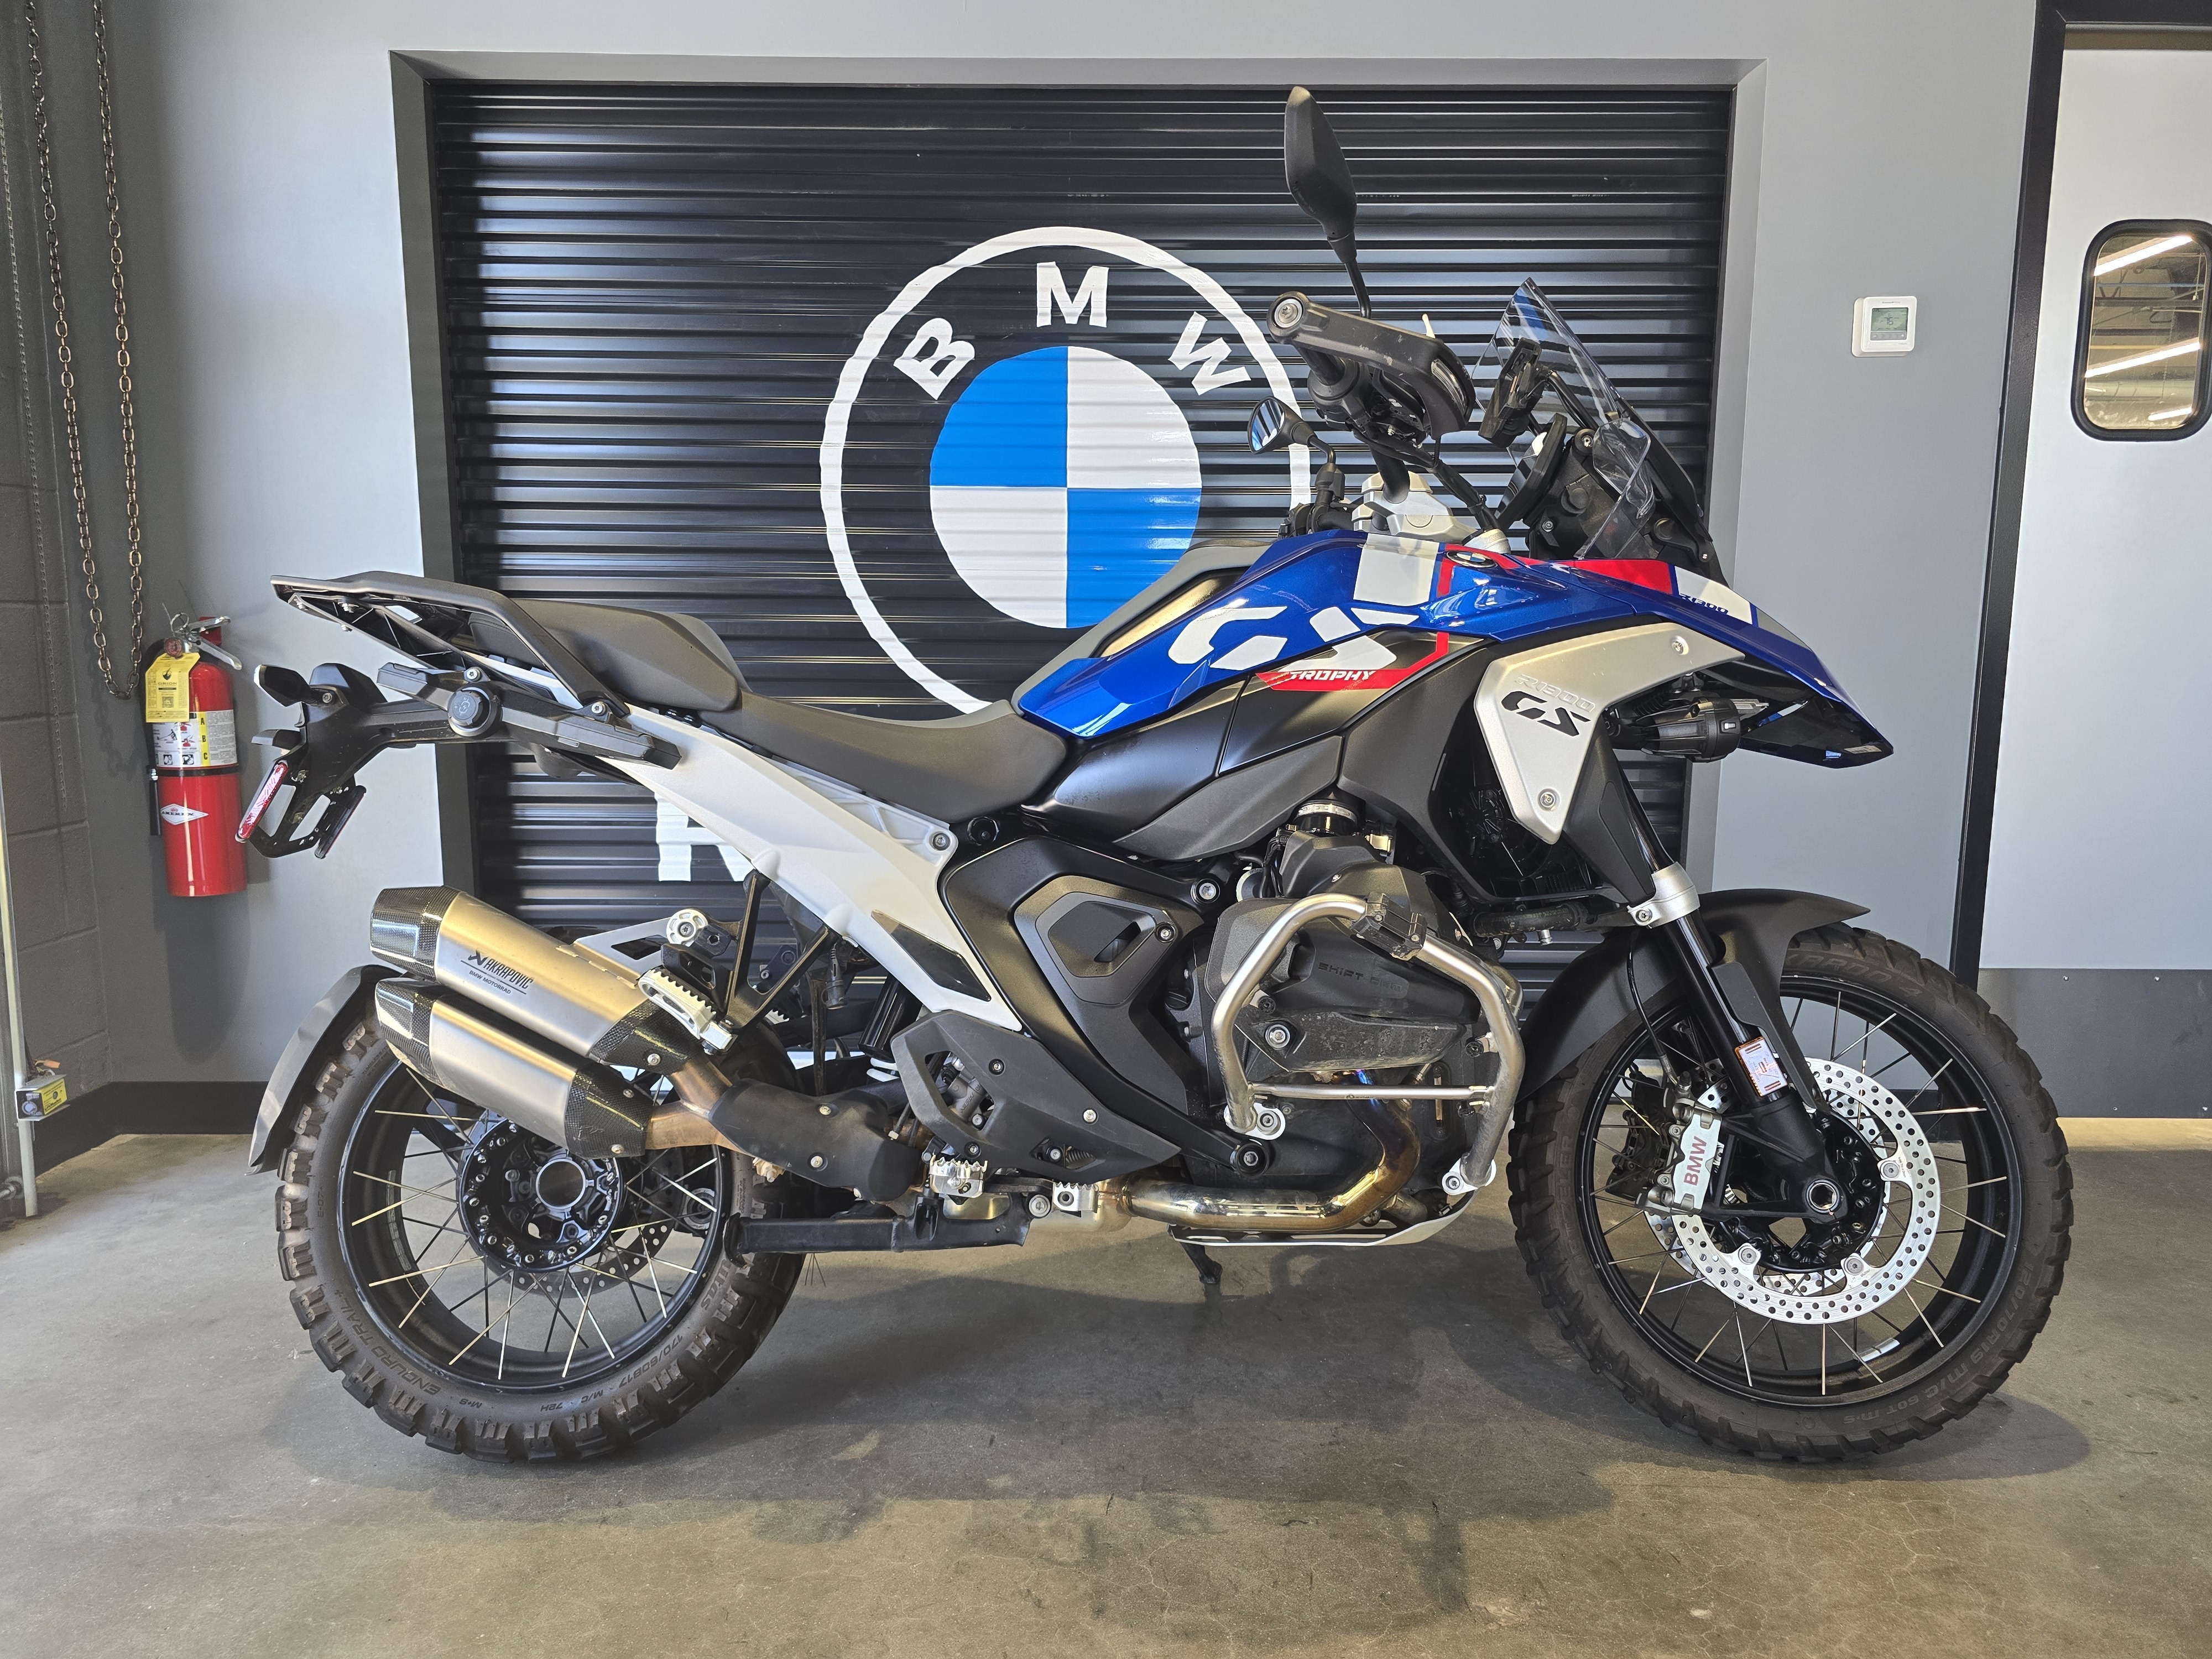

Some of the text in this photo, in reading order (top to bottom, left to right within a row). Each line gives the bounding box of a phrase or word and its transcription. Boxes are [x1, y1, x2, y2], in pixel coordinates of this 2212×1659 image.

[894, 262, 1252, 400] BMW
[1168, 606, 1420, 672] GS
[1288, 670, 1377, 681] TROPHY
[1515, 674, 1596, 713] R1300
[1501, 691, 1592, 737] GS
[469, 970, 483, 980] BMW
[482, 977, 512, 994] MOTORRAD
[1318, 962, 1364, 980] SHIFT
[1683, 1135, 1707, 1186] BMW
[371, 1345, 442, 1396] ENDURO
[540, 1401, 564, 1412] 72H
[581, 1389, 604, 1404] M/C
